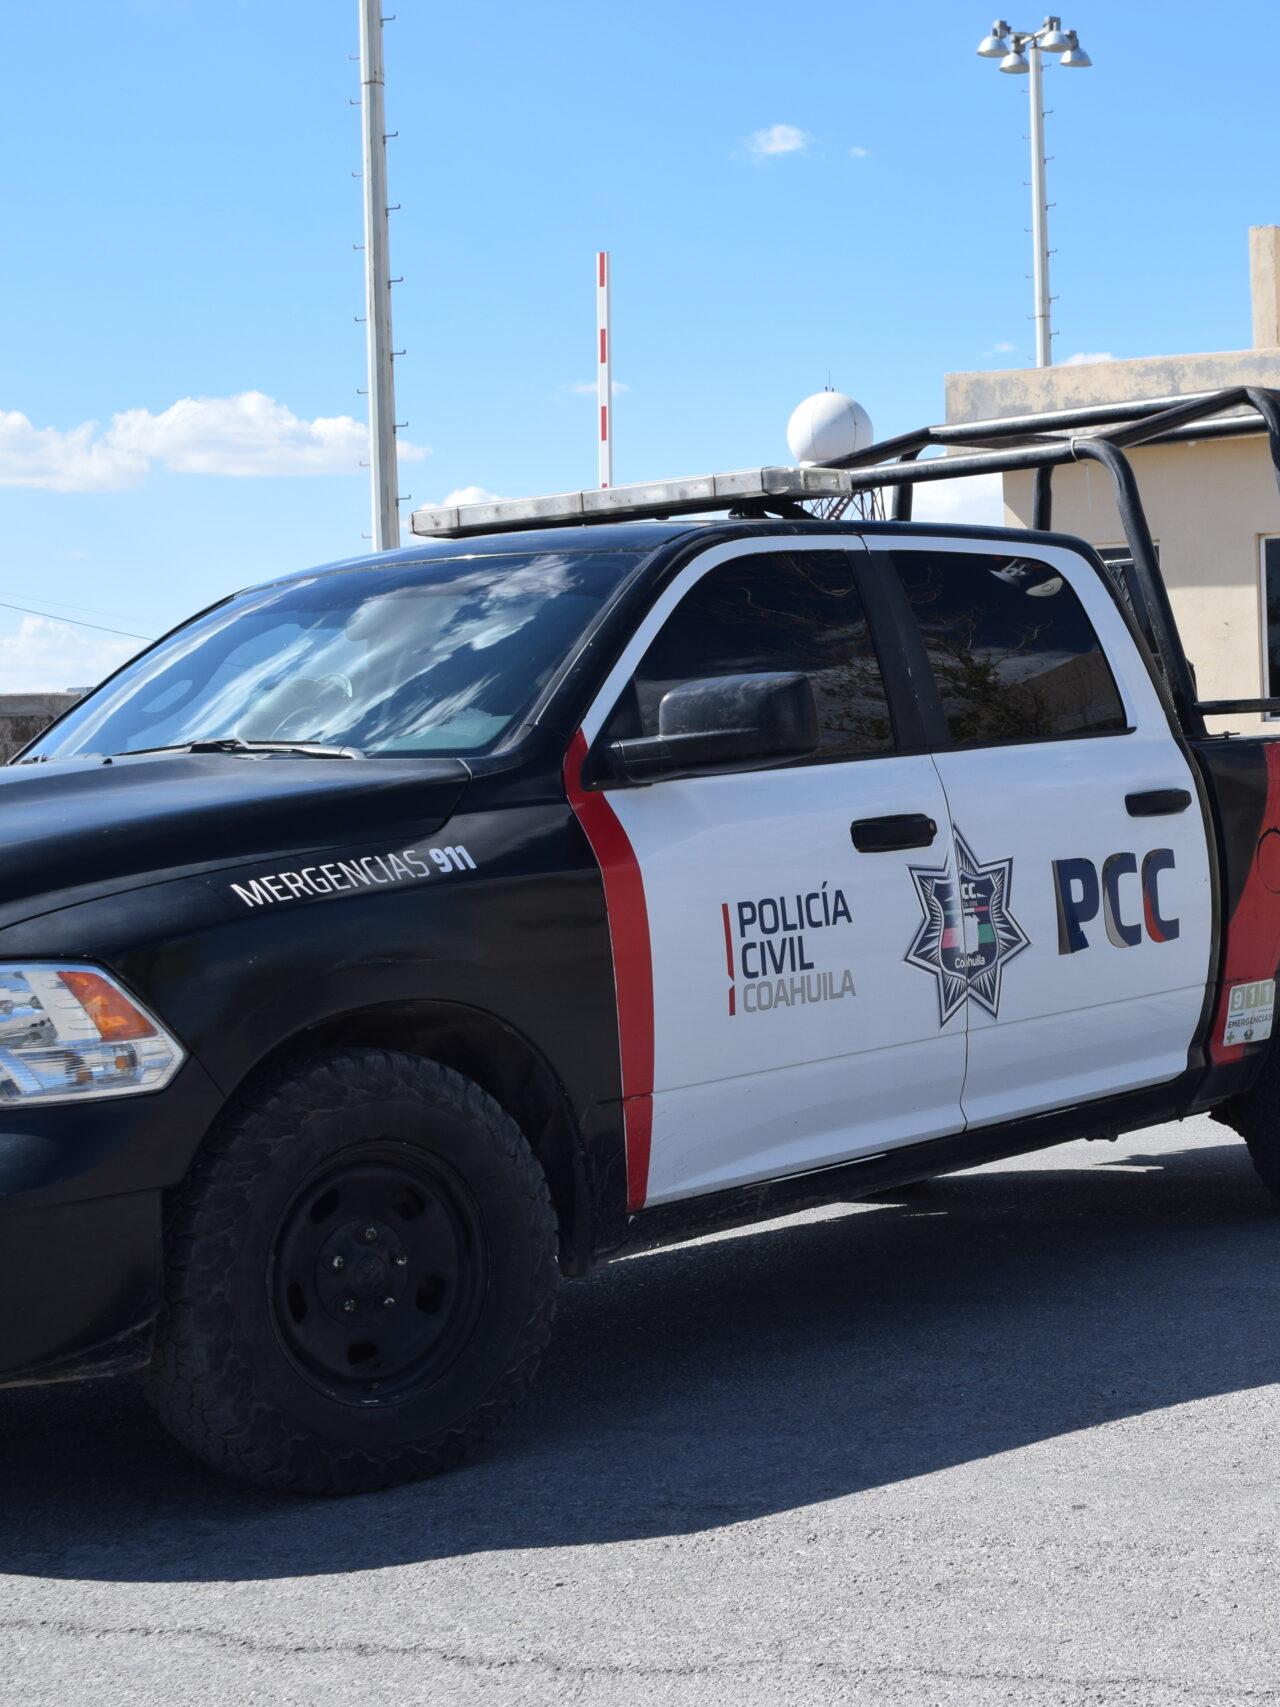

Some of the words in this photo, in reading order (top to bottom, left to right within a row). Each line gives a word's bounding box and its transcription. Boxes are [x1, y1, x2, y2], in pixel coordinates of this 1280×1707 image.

[230, 850, 430, 907] MERGENCIAS
[429, 846, 477, 873] 911
[1052, 848, 1180, 955] PCC
[737, 881, 853, 938] POLICÍA
[741, 936, 814, 979] CIVIL
[743, 970, 857, 1013] COAHUILA
[1234, 986, 1271, 1009] 911
